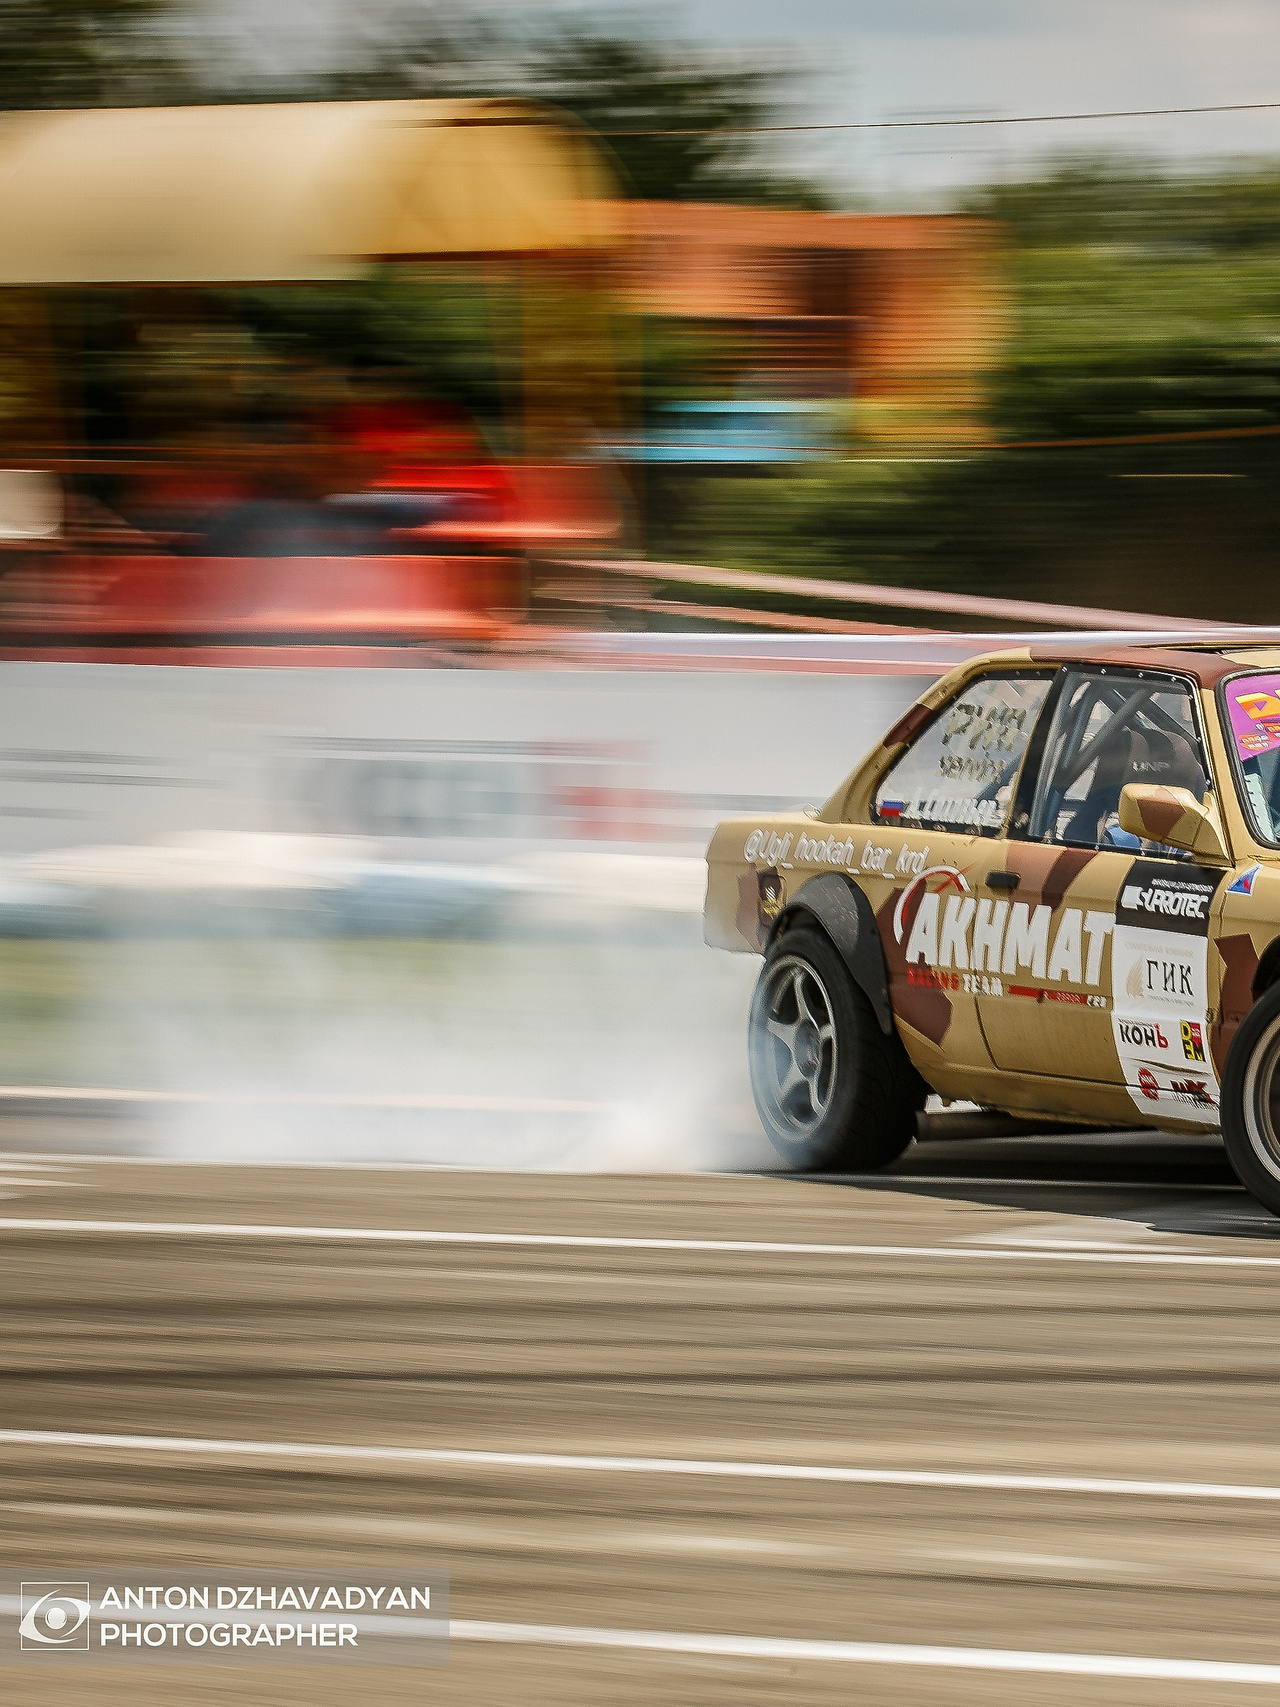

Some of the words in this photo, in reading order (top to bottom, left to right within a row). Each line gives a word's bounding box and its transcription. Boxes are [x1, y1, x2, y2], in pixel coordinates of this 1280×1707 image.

[905, 892, 1116, 986] AKHMAT
[907, 967, 960, 991] RACING
[962, 973, 1004, 996] TEAM
[1146, 958, 1195, 996] ГИК
